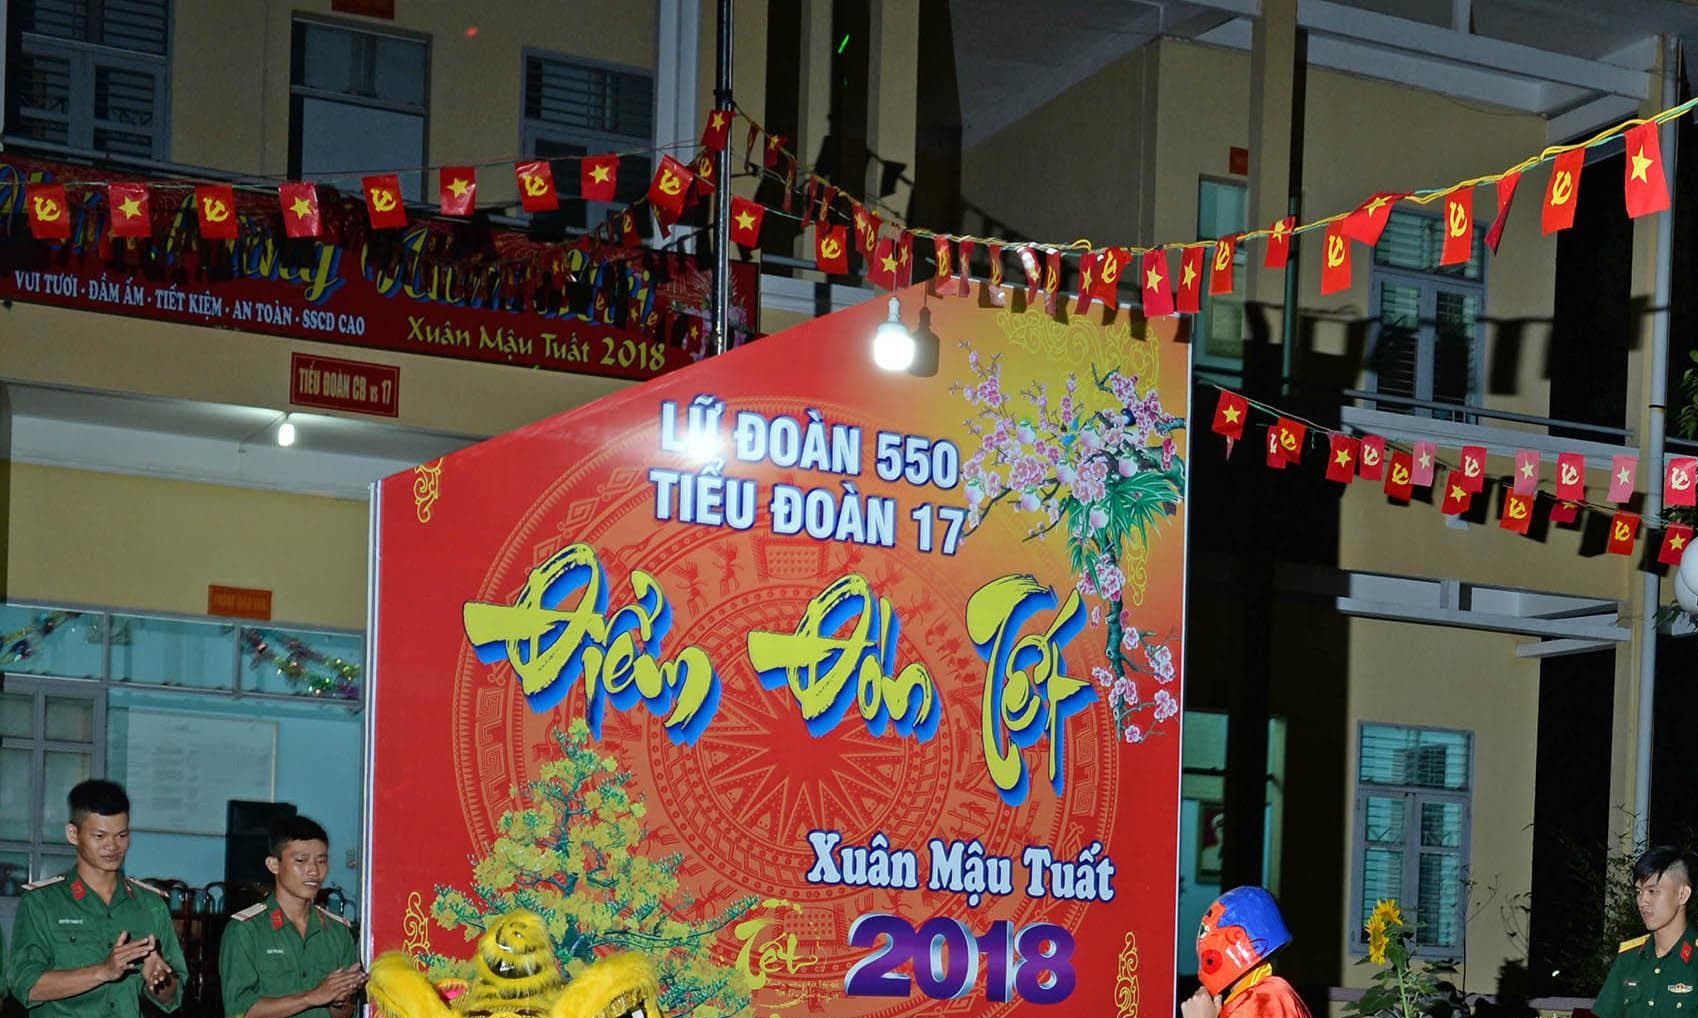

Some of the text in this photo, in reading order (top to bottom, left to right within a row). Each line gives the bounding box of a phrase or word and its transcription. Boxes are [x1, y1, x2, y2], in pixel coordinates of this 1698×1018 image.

[15, 270, 40, 293] VUI
[44, 272, 78, 298] TƯƠI
[89, 271, 120, 304] ĐẦM
[123, 276, 145, 307] ẤM
[155, 283, 186, 313] TIẾT
[189, 290, 223, 321] KIỆM
[233, 300, 253, 321] AN
[256, 299, 292, 326] TOÀN
[338, 313, 366, 337] CAO
[407, 315, 667, 372] Xuân Mậu Tuất 2018
[382, 378, 392, 406] 17
[733, 406, 863, 477] ĐOÀN
[875, 429, 961, 491] 550
[648, 456, 968, 557] TIỂU ĐOÀN 17
[463, 543, 1095, 794] Điểm Đón Tết
[806, 830, 1116, 908] Xuân Mậu Tuất
[845, 911, 1078, 1005] 2018
